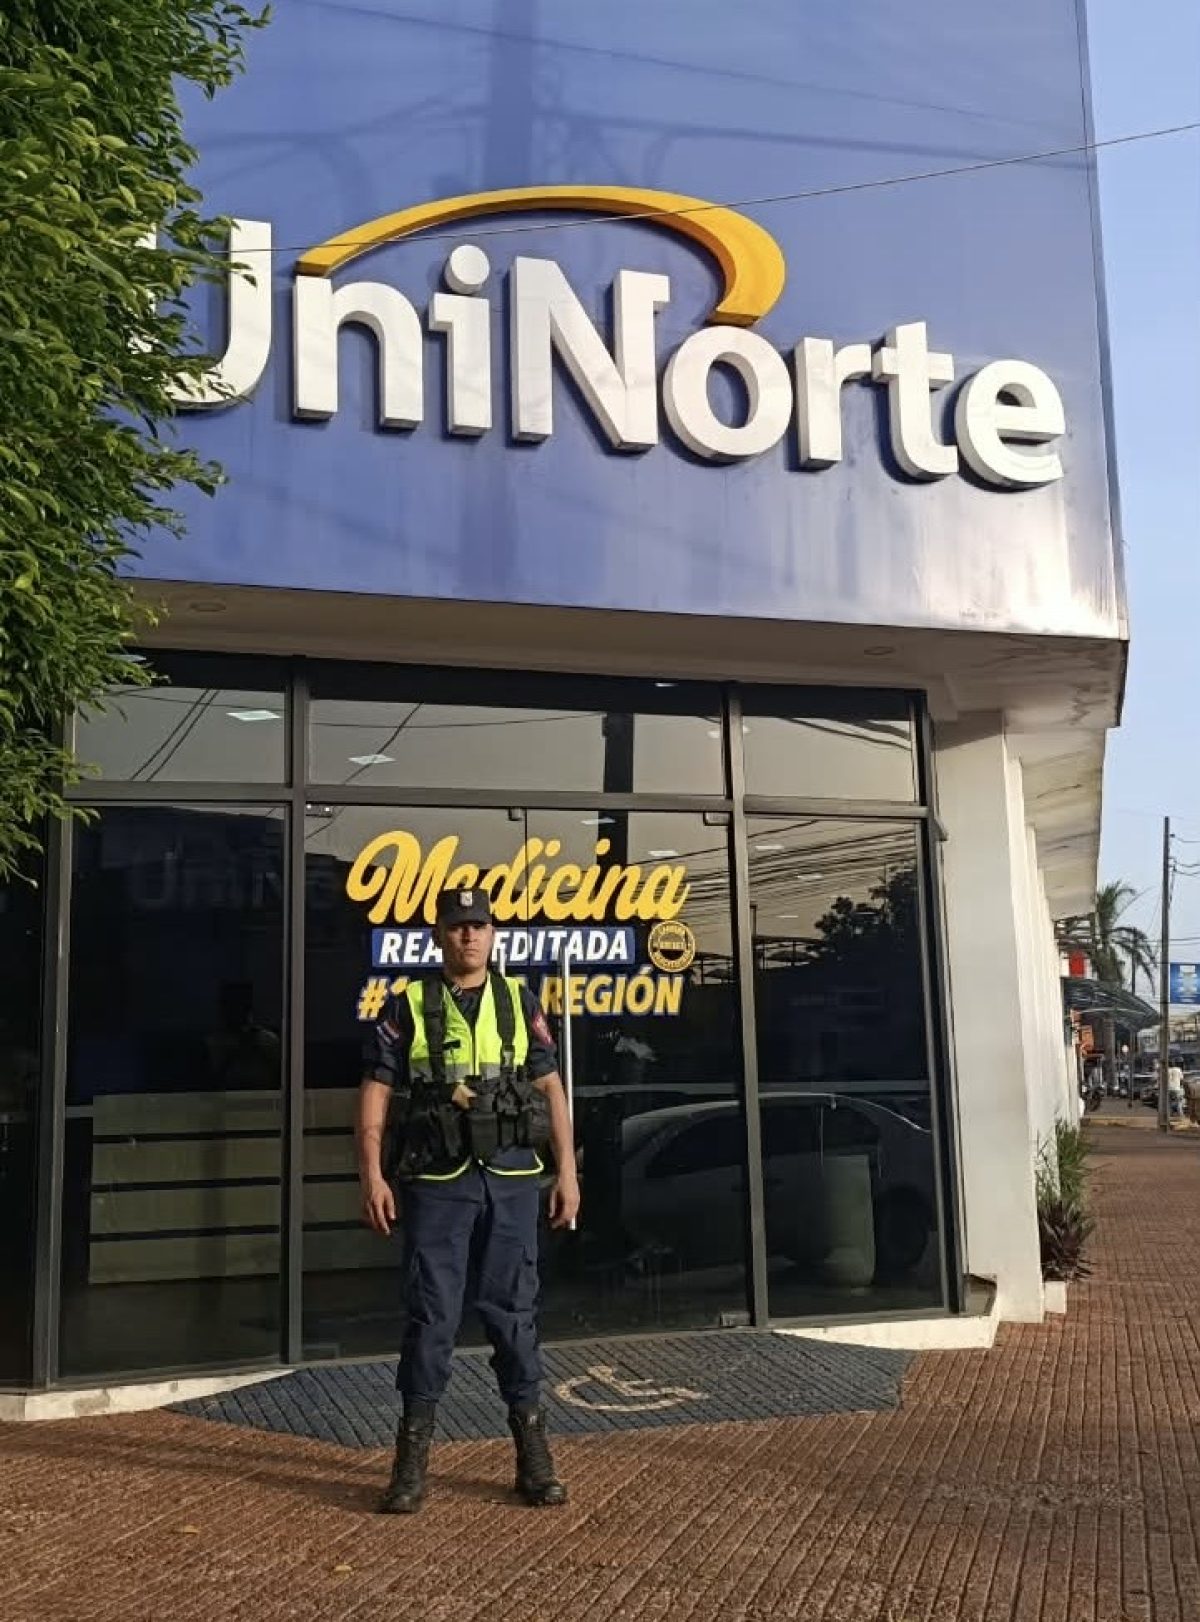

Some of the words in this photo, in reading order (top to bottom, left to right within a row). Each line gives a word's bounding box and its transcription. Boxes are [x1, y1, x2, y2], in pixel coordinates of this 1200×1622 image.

[124, 218, 1066, 490] UniNorte
[379, 930, 628, 964] REAEDITADA
[541, 965, 684, 1016] REGIÓN
